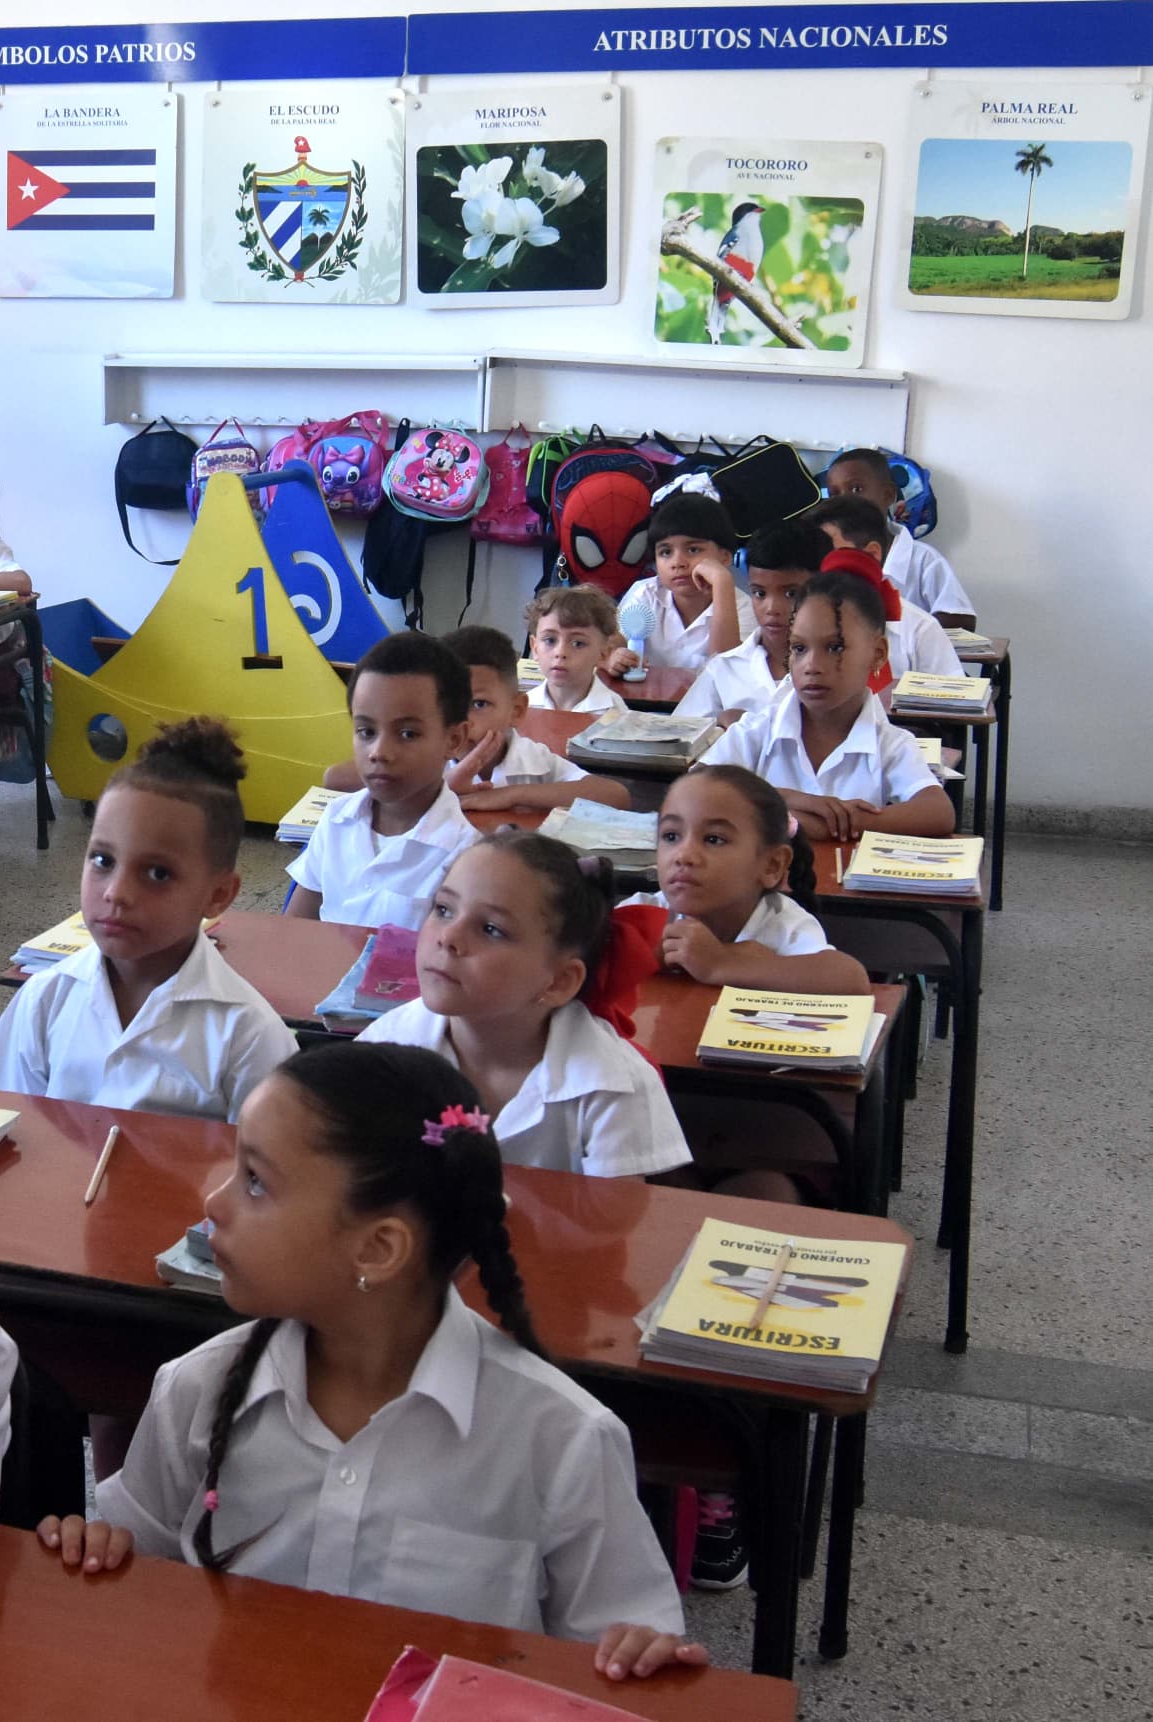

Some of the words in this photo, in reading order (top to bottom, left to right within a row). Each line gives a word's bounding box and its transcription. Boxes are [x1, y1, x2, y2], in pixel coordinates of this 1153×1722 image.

[593, 27, 751, 51] ATRIBUTOS
[758, 24, 948, 49] NACIONALES
[95, 42, 197, 64] PATRIOS
[45, 108, 60, 118] LA
[63, 107, 121, 118] BANDERA
[269, 105, 286, 116] EL
[288, 104, 340, 116] ESCUDO
[475, 106, 547, 120] MARIPOSA
[981, 102, 1033, 114] PALMA
[1037, 102, 1079, 115] REAL
[726, 158, 808, 171] TOCORORO
[236, 567, 284, 670] 1
[726, 1039, 832, 1055] ESCRITURA
[719, 1239, 778, 1256] TRABAJO
[800, 1253, 871, 1265] CUADERNO
[698, 1318, 841, 1351] ESCRITURA
